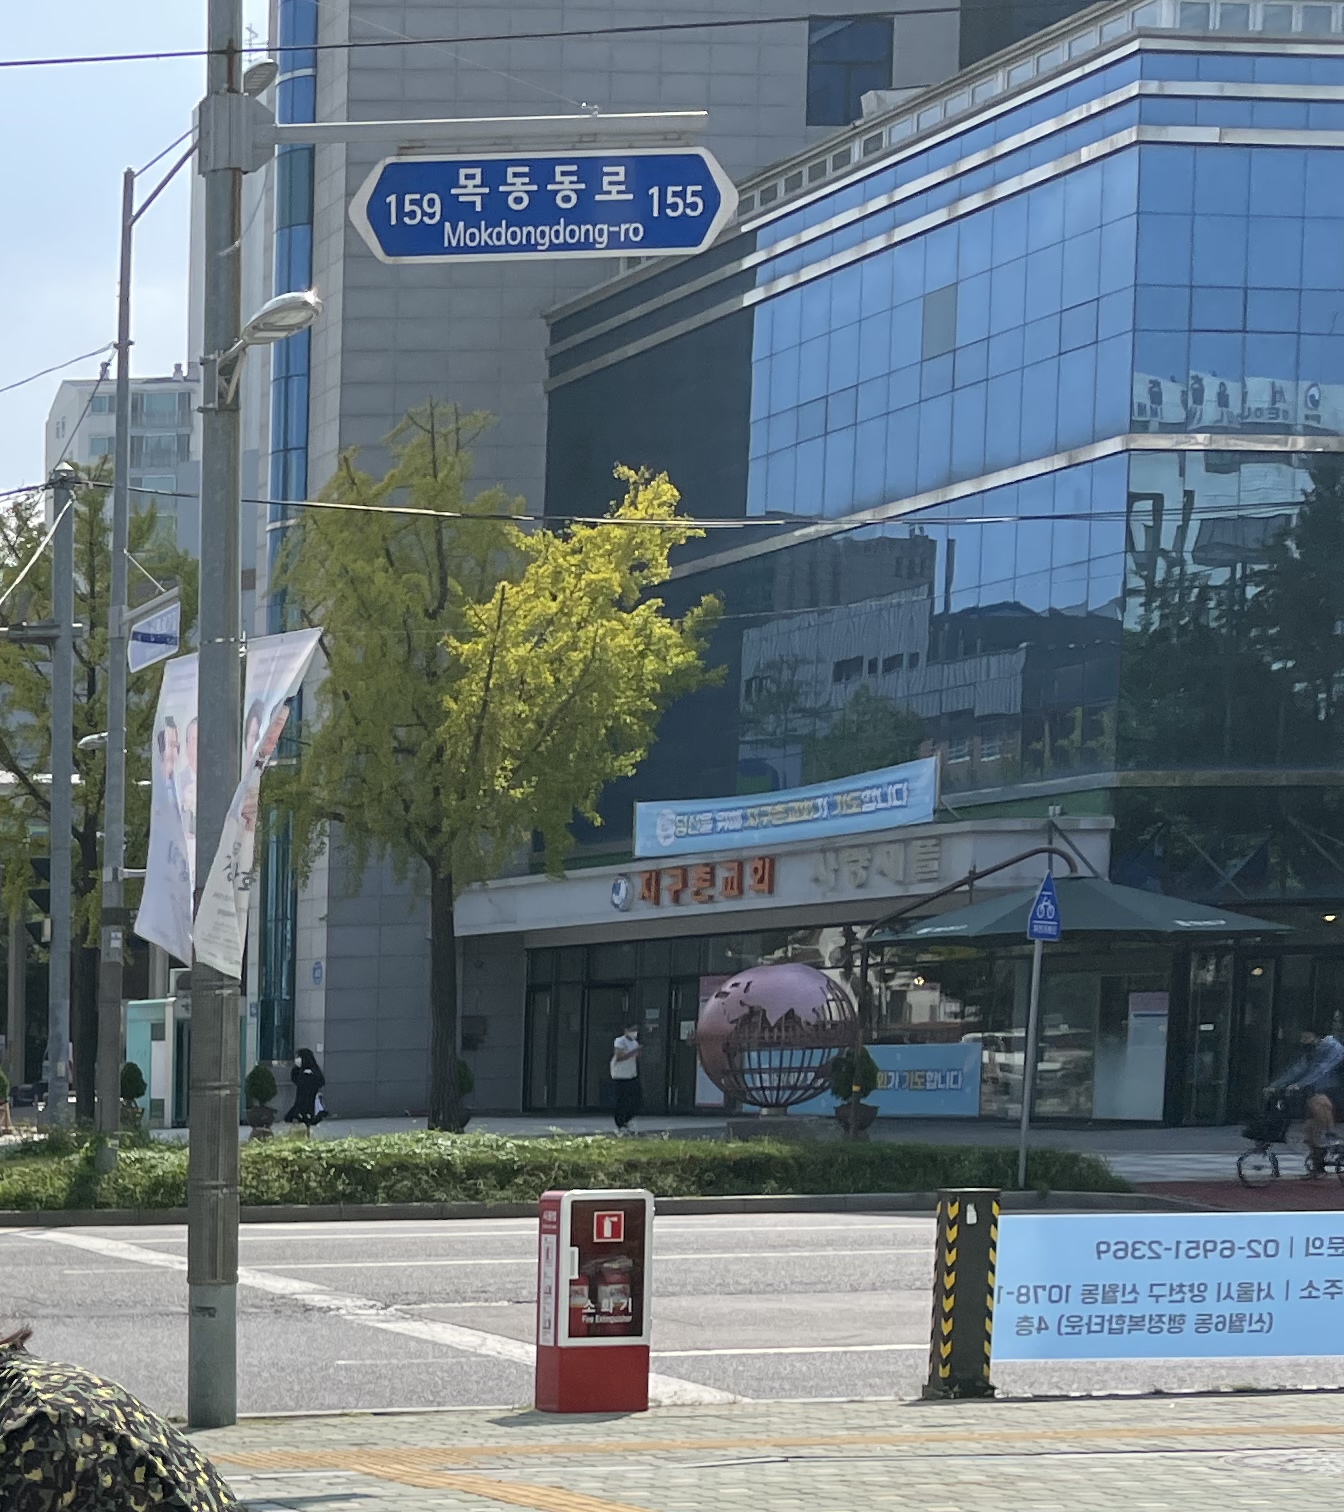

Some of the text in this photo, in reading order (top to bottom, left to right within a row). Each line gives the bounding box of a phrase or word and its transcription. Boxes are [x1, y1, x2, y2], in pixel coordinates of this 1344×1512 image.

[386, 164, 704, 226] 159 목동동로 155
[443, 219, 644, 251] Mokdongdong-ro
[639, 856, 775, 906] 지구촌교회
[581, 1297, 632, 1314] 소화기
